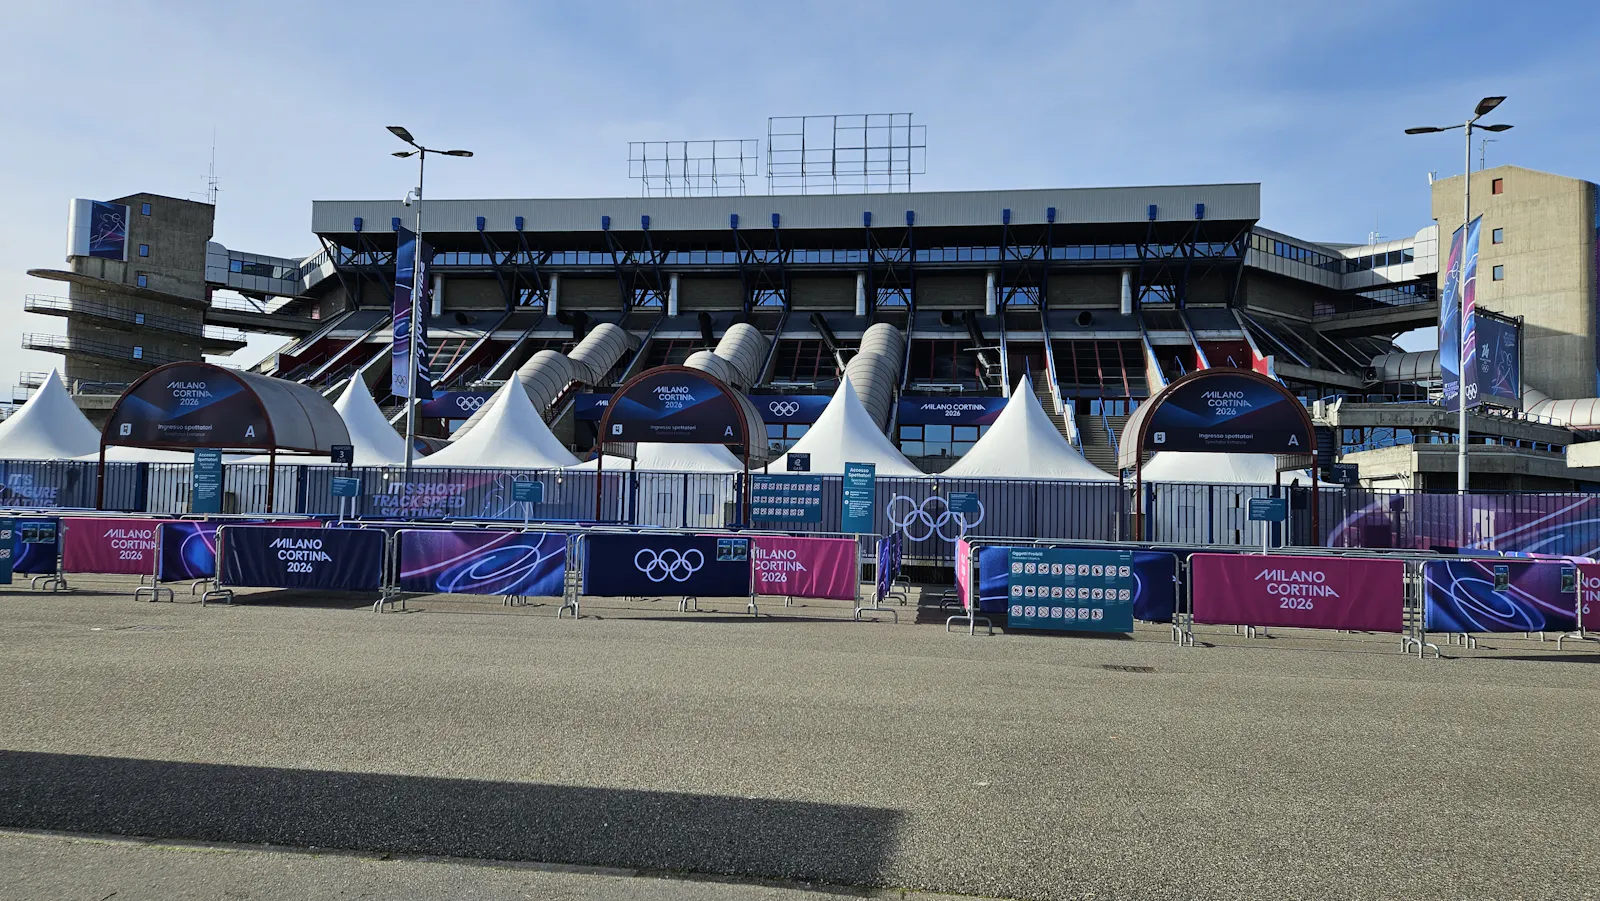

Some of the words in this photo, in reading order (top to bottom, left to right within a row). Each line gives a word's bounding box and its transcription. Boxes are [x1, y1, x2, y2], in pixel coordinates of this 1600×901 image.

[166, 381, 206, 389] MILANO
[173, 389, 214, 398] CORTINA
[658, 394, 696, 402] CORTINA
[1200, 390, 1244, 399] MILANO
[180, 398, 199, 406] 2026
[1208, 399, 1252, 408] CORTINA
[1216, 407, 1237, 416] 2026
[244, 425, 256, 438] A
[724, 426, 734, 436] A
[1288, 434, 1299, 446] A
[8, 473, 33, 485] IT'S
[12, 486, 58, 498] FIGURE
[388, 482, 415, 494] IT'S
[416, 483, 466, 495] SHORT
[372, 494, 420, 508] TRACK
[422, 495, 466, 508] SPEED
[103, 529, 152, 539] MILANO
[269, 538, 323, 550] MILANO
[120, 550, 143, 560] 2026
[278, 550, 332, 562] CORTINA
[287, 562, 313, 573] 2026
[762, 572, 787, 582] 2026
[1254, 568, 1326, 583] MILANO
[1266, 582, 1340, 598] CORTINA
[1280, 597, 1314, 610] 2026
